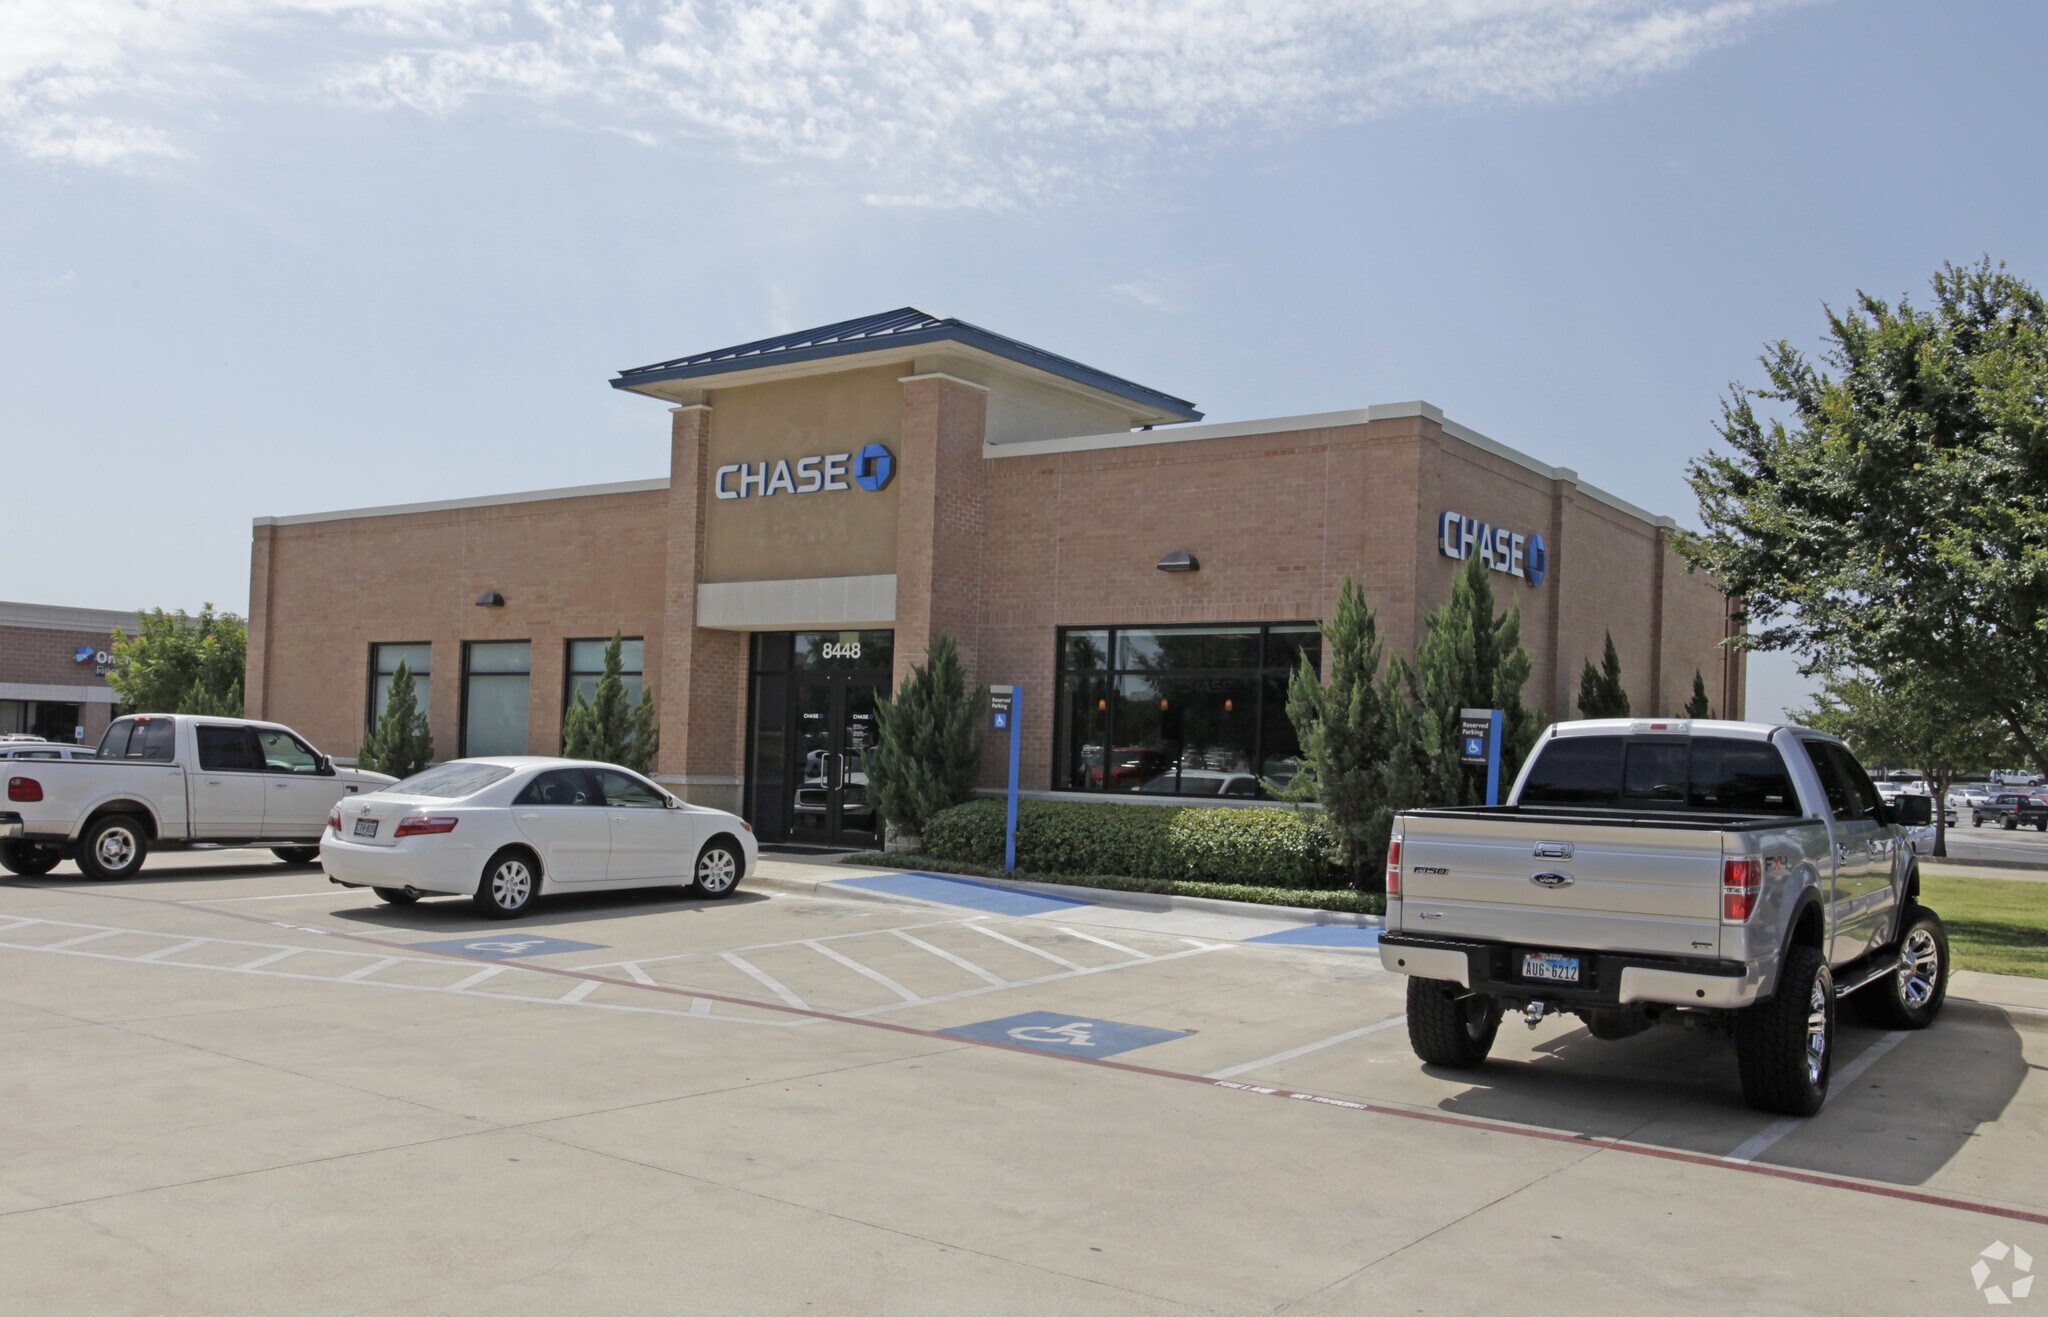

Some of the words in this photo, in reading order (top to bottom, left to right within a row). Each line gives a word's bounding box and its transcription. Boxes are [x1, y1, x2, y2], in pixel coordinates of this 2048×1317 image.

[715, 453, 852, 499] CHASE
[1439, 511, 1525, 578] CHASE
[822, 642, 861, 659] 8448
[1462, 721, 1489, 729] Reserved
[1462, 729, 1484, 737] Parking
[1539, 874, 1559, 884] Ford
